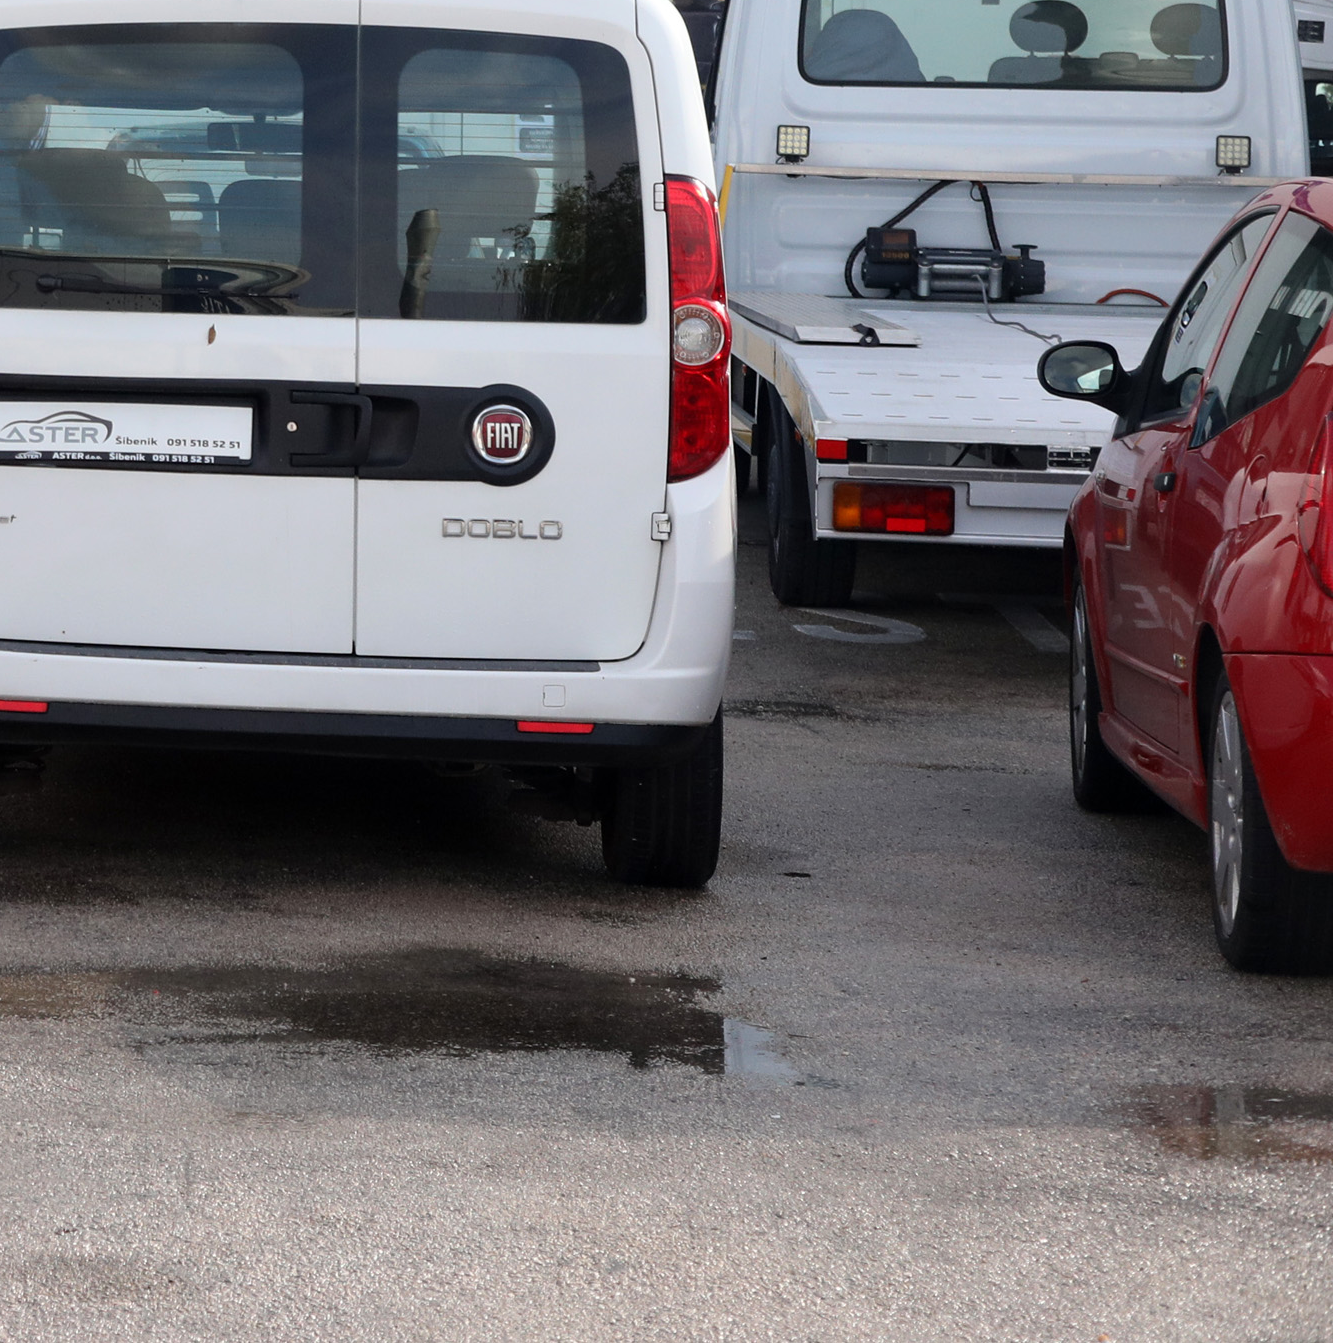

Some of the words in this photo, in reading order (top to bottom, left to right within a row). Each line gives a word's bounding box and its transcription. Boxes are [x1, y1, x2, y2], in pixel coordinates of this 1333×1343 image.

[115, 435, 158, 446] Šibenik
[166, 438, 187, 447] 091
[190, 439, 210, 448] 518
[212, 440, 226, 449] 52
[228, 441, 241, 449] 51
[486, 423, 521, 449] FIAT
[52, 452, 84, 460] ASTER
[109, 452, 146, 461] Šibenik
[171, 455, 188, 463] 518
